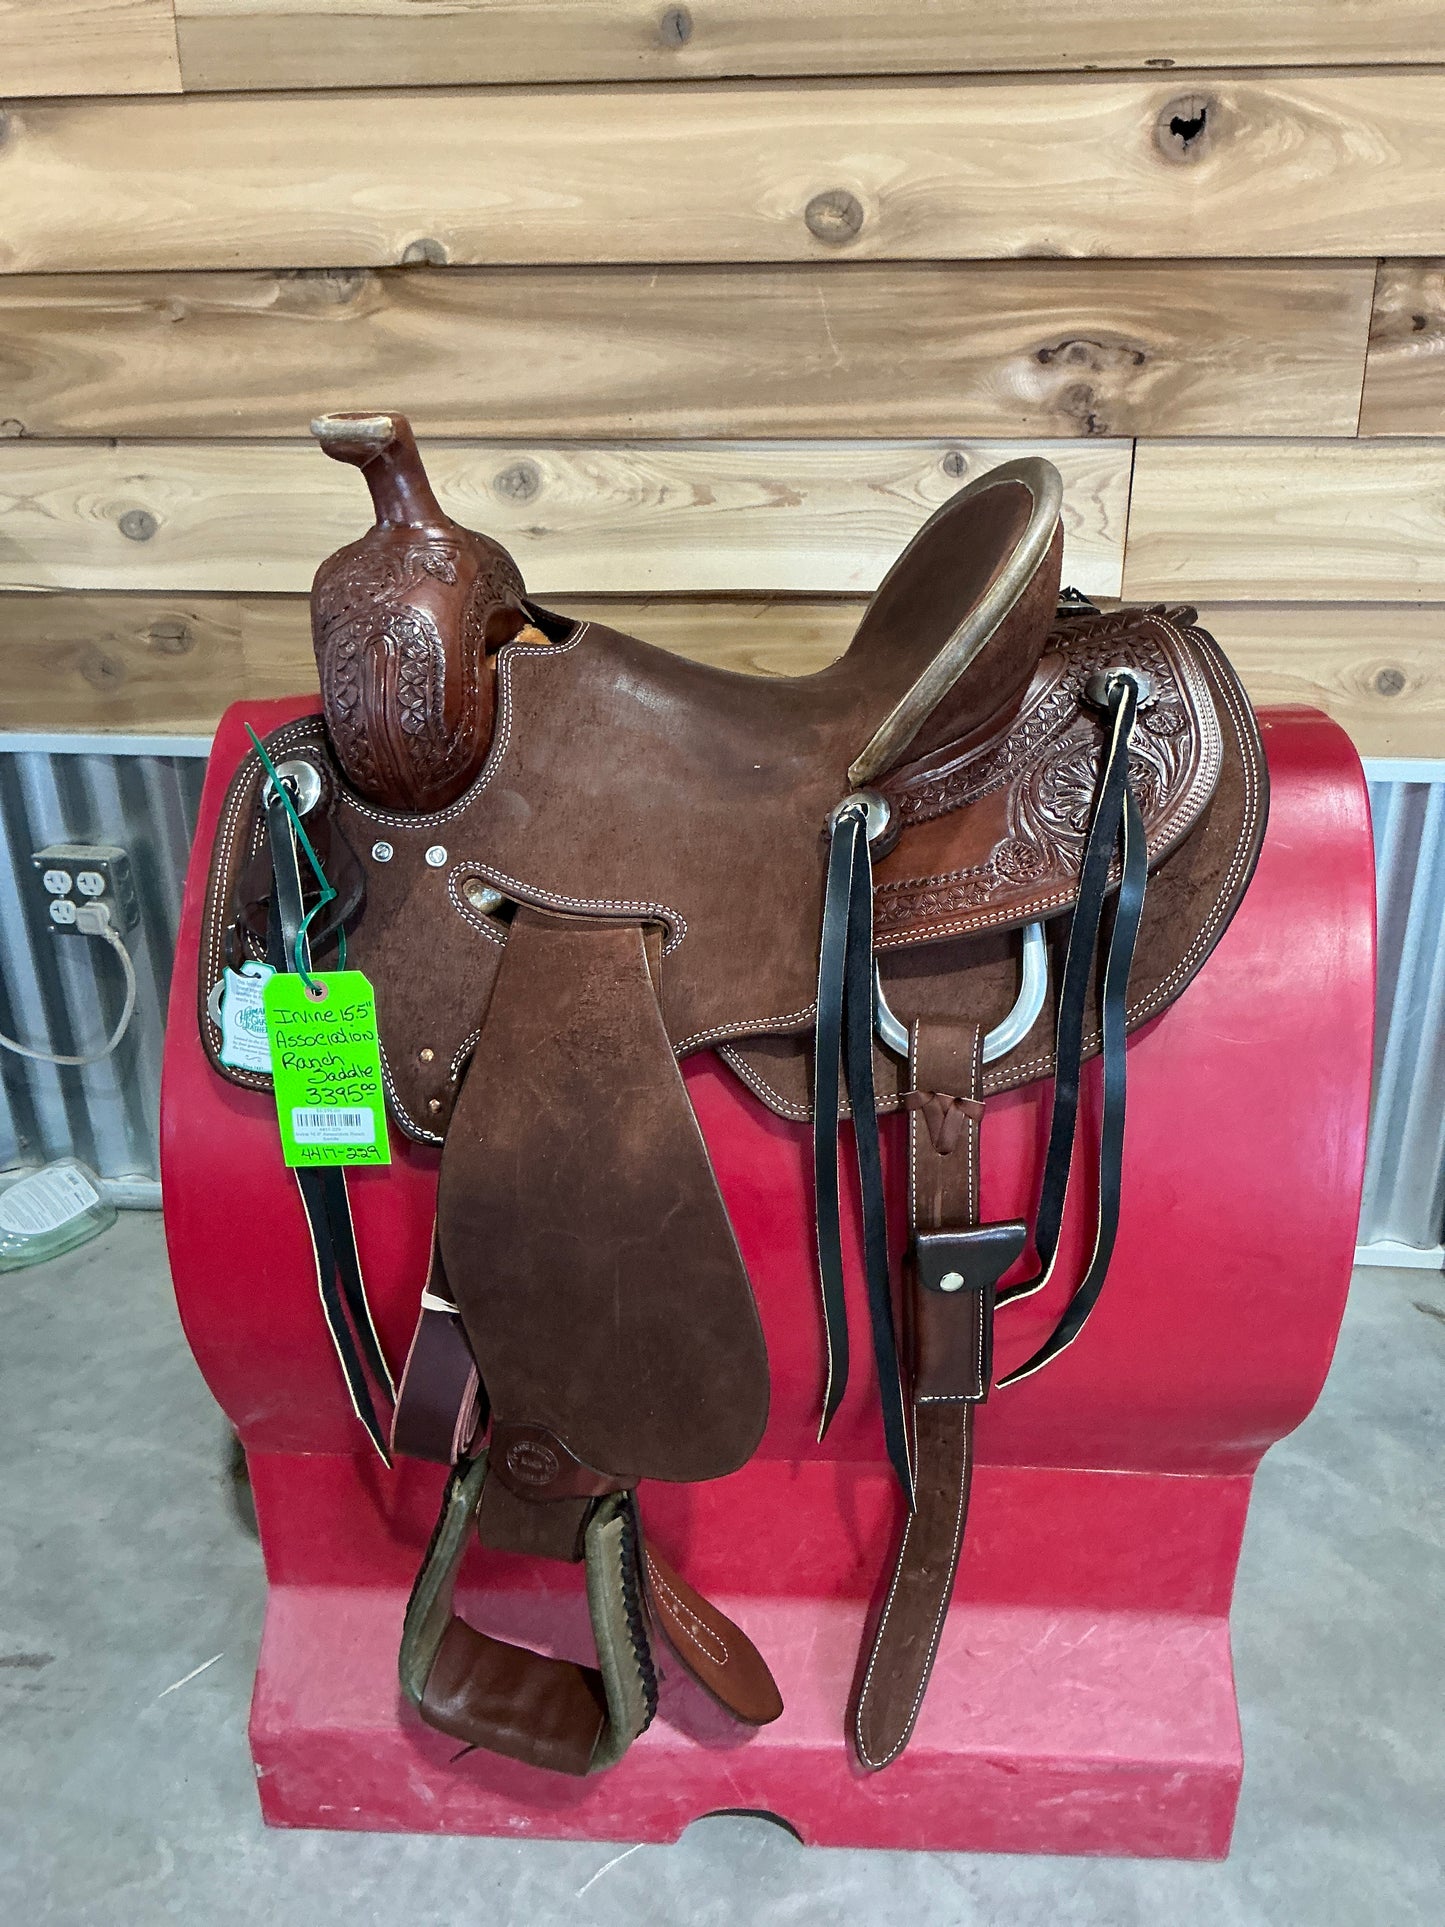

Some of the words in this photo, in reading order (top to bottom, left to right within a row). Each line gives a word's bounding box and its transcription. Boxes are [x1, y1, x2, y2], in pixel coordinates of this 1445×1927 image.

[273, 1009, 338, 1024] Irvine
[276, 1028, 374, 1048] Association
[282, 1051, 345, 1071] Ranch
[308, 1063, 373, 1084] Saddle
